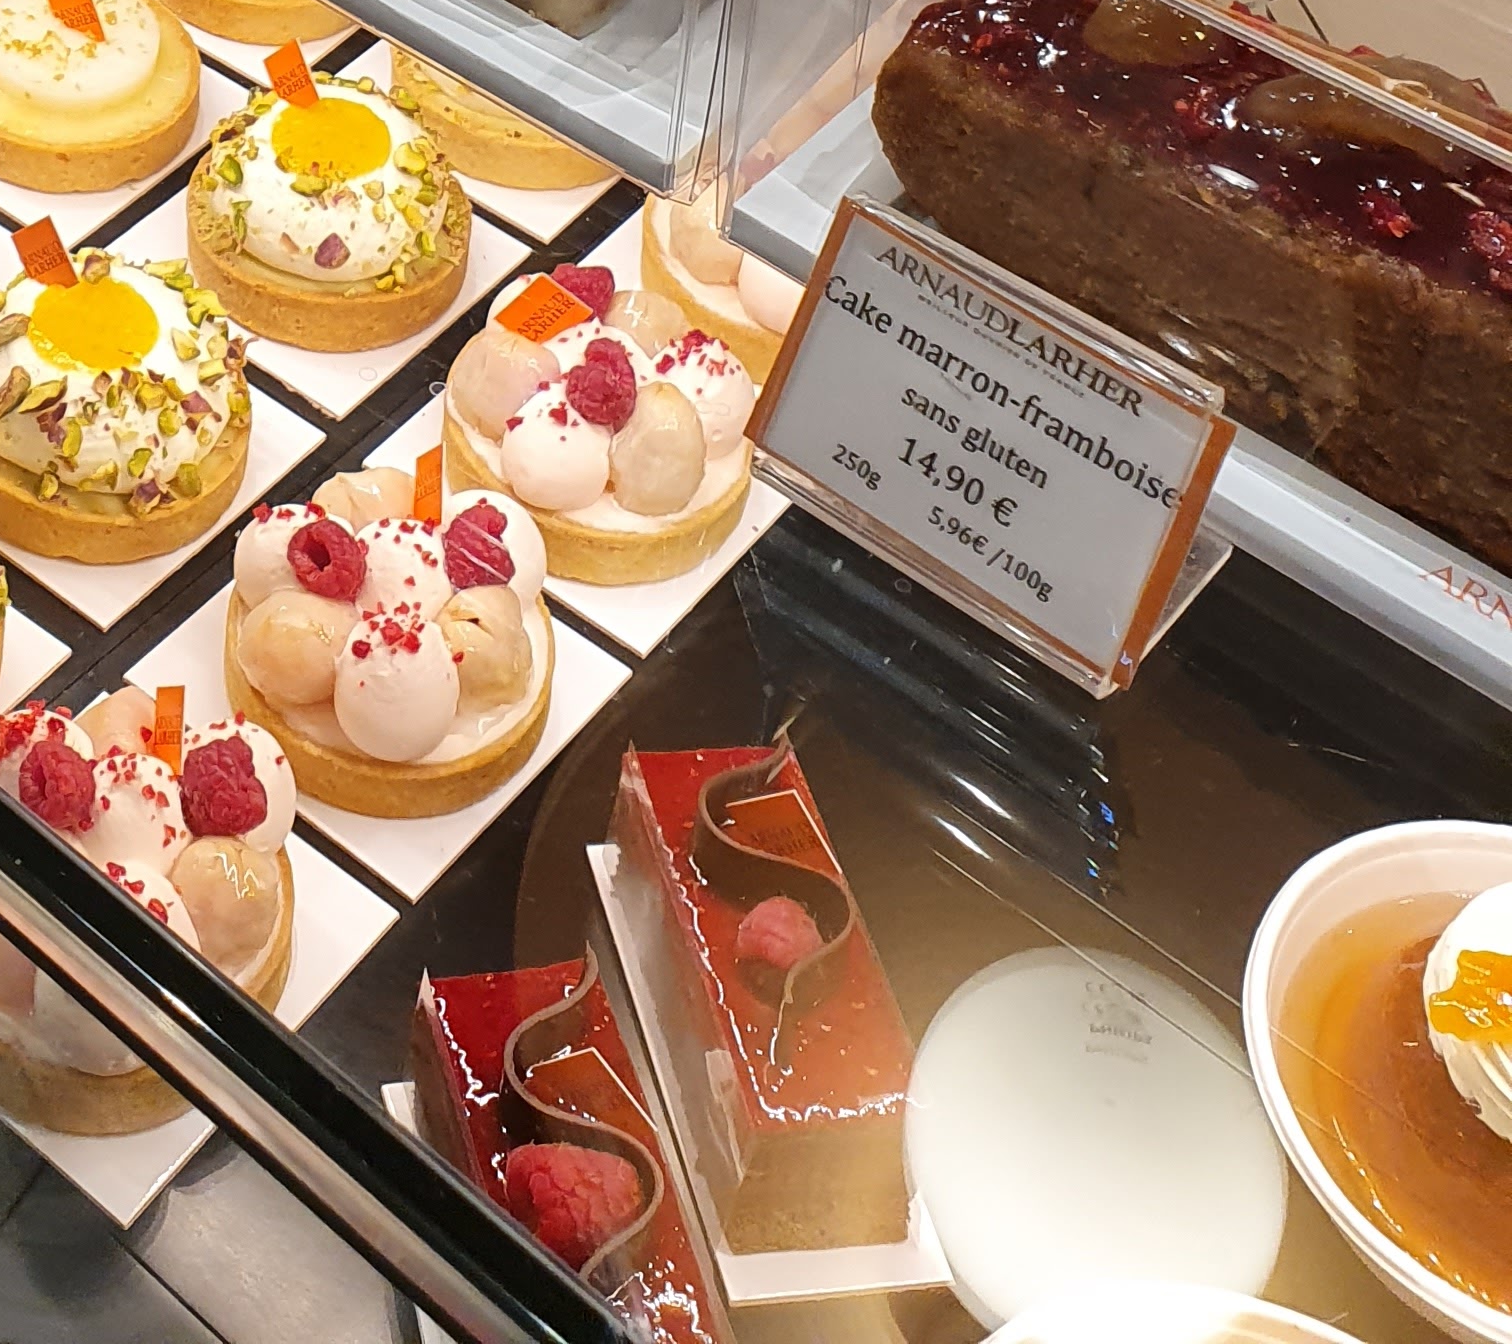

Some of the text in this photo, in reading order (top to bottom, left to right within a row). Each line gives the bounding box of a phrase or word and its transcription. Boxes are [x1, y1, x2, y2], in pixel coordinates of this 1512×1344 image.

[824, 275, 894, 335] Cake
[896, 322, 1183, 509] marron-framboise
[875, 245, 1143, 418] ARNAUDLARHER
[897, 437, 1019, 528] 14,90 €
[901, 387, 1049, 490] sans gluten
[831, 443, 1055, 604] 250g 5,96€ /100g
